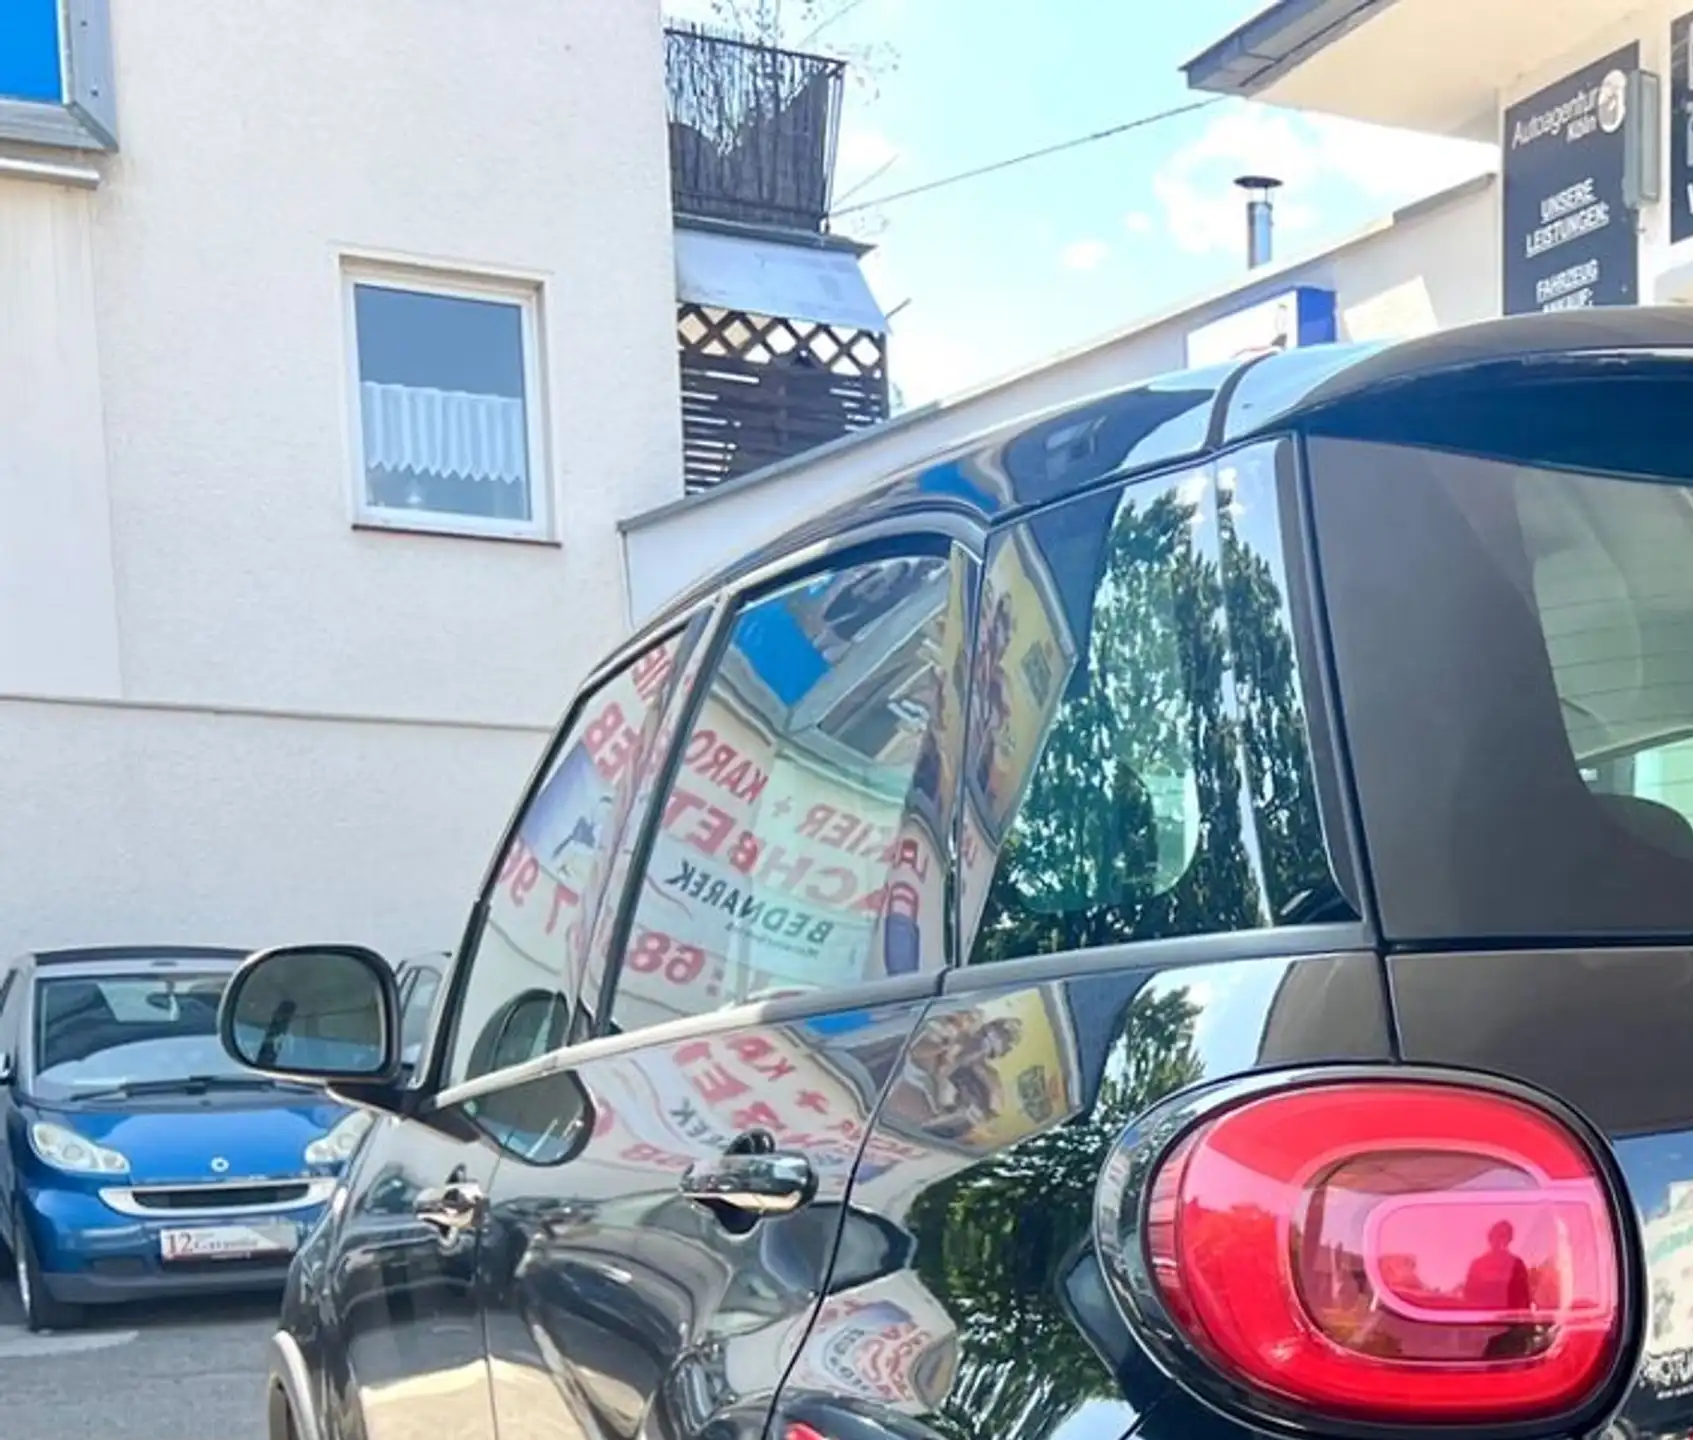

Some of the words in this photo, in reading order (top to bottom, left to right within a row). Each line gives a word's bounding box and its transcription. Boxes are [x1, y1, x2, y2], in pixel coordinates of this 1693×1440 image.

[1511, 87, 1600, 149] Autoagentur
[1556, 114, 1598, 143] Köln
[1540, 177, 1598, 225] UNSERE
